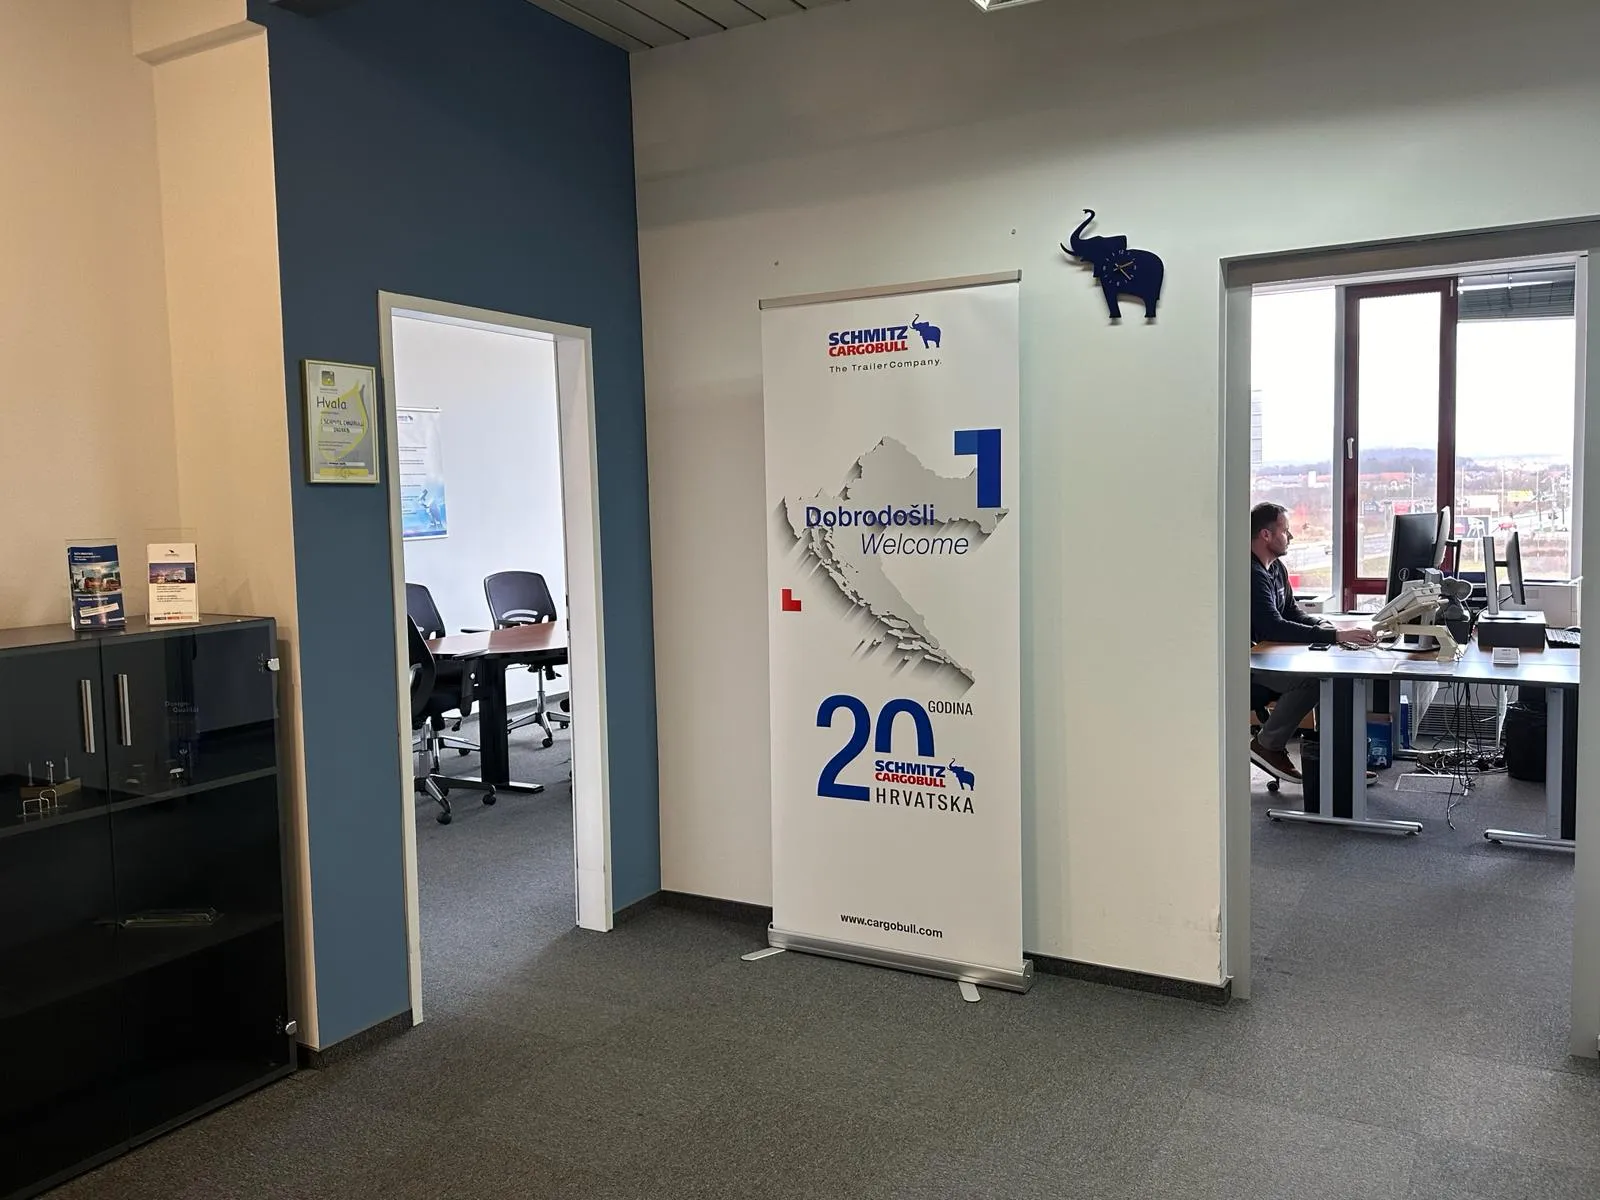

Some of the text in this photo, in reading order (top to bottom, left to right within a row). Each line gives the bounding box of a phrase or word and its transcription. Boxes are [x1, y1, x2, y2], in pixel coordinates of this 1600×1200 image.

[828, 325, 908, 346] SCHMITZ
[828, 341, 908, 357] CARGOBULL
[316, 396, 347, 410] Hvala
[805, 504, 935, 527] Dobrodošli
[861, 533, 969, 555] Welcome
[927, 700, 974, 716] GODINA
[816, 694, 935, 802] 20
[875, 759, 946, 778] SCHMITZ
[875, 772, 946, 788] CARGOBULL
[876, 787, 975, 814] HRVATSKA
[840, 914, 943, 938] www.cargobull.com
